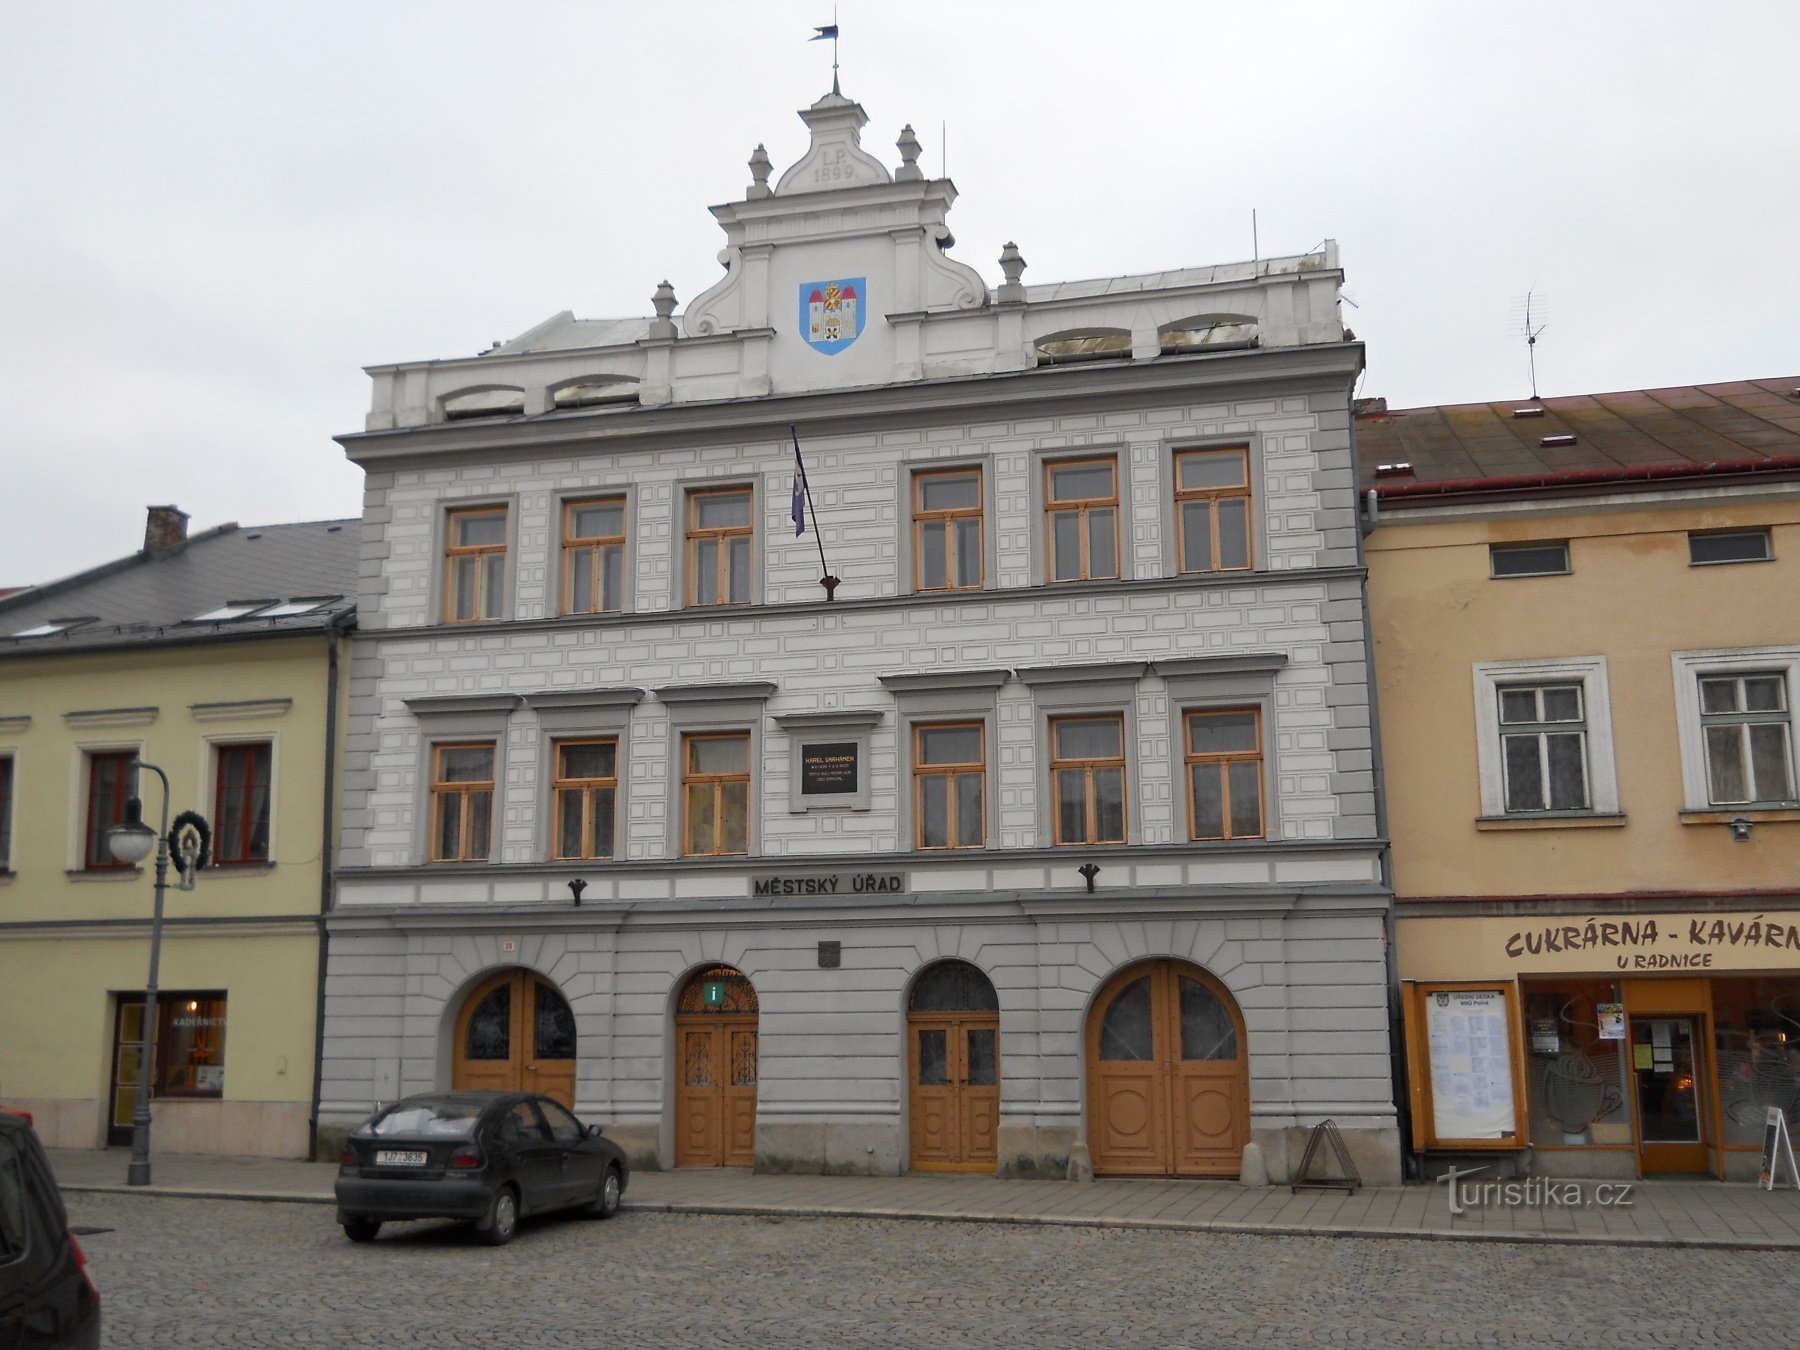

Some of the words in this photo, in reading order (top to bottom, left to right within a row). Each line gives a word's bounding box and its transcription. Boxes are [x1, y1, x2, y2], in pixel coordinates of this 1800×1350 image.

[755, 874, 839, 894] MĚSTSKÝ
[852, 873, 901, 893] ÚŘAD
[1504, 917, 1657, 958] CUKRÁRNA
[1616, 955, 1628, 969] U
[1634, 953, 1713, 969] RADNICE
